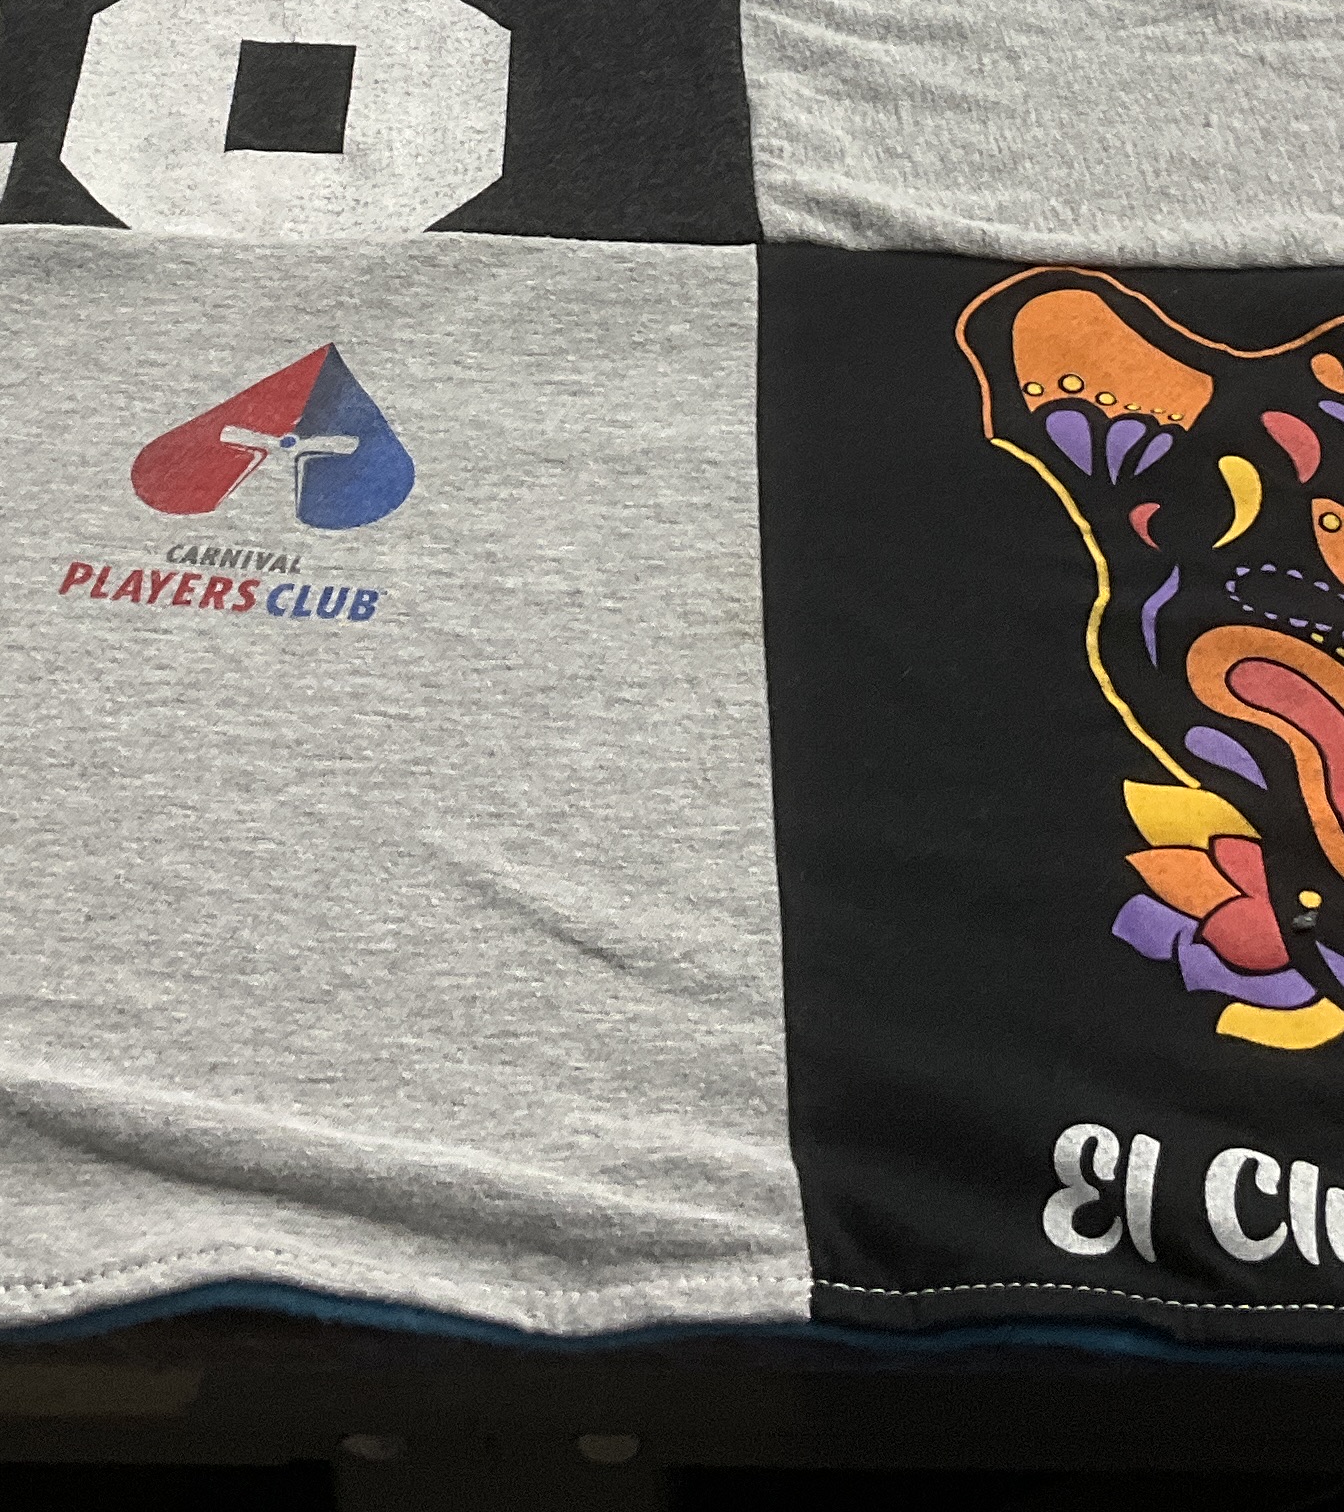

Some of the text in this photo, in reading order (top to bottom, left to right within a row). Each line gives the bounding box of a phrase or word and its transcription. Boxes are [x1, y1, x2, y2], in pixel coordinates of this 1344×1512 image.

[166, 543, 301, 575] CARNIVAL
[58, 561, 384, 622] PLAYERS CLUB
[1042, 1123, 1160, 1263] El
